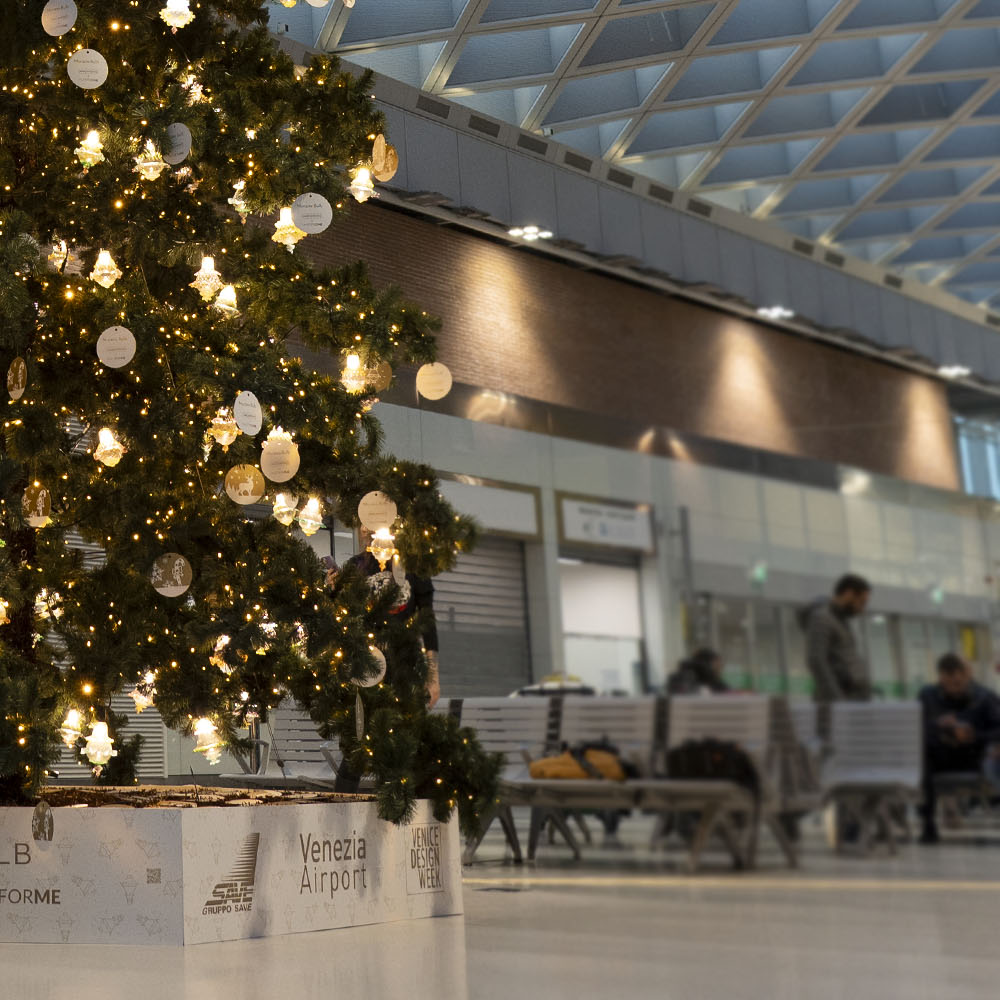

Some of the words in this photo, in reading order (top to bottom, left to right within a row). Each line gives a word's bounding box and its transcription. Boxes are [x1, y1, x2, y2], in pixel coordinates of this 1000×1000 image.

[299, 830, 367, 864] Venezia
[411, 826, 439, 848] VENICE
[410, 847, 440, 869] DESIGN
[300, 863, 368, 899] Airport
[418, 868, 442, 889] WEEK
[202, 905, 232, 916] GRUPPO
[234, 903, 252, 912] SAVE
